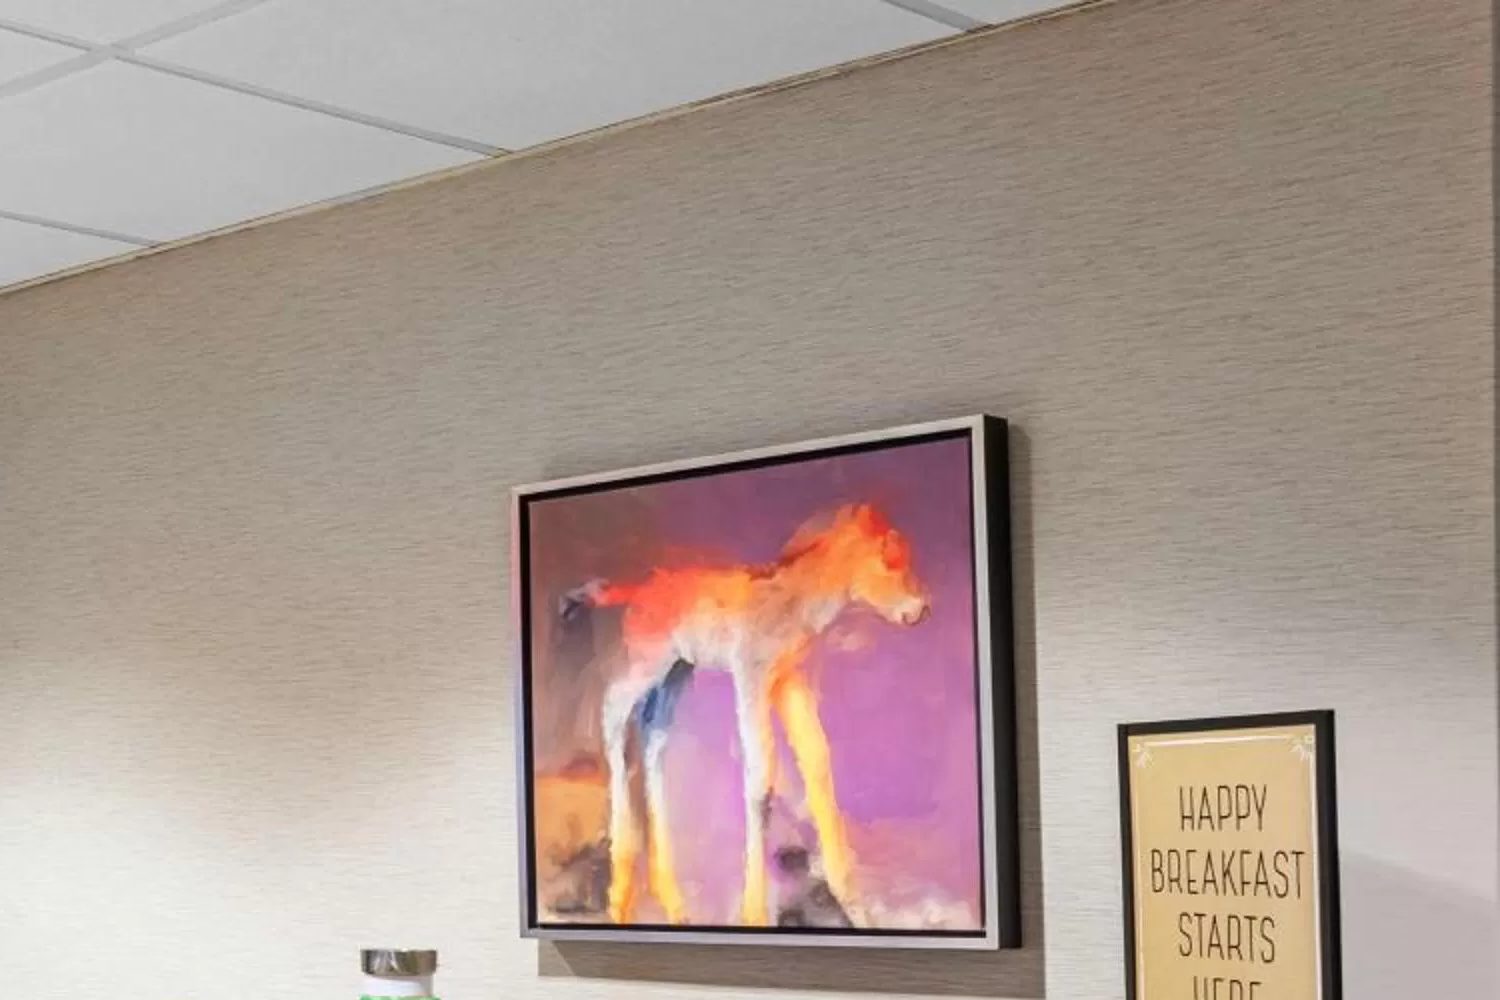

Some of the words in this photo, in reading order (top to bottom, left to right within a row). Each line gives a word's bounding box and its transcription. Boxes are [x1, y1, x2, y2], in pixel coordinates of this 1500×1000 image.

[1179, 783, 1268, 832] HAPPY
[1151, 848, 1305, 899] BREAKFAST
[1178, 911, 1276, 964] STARTS
